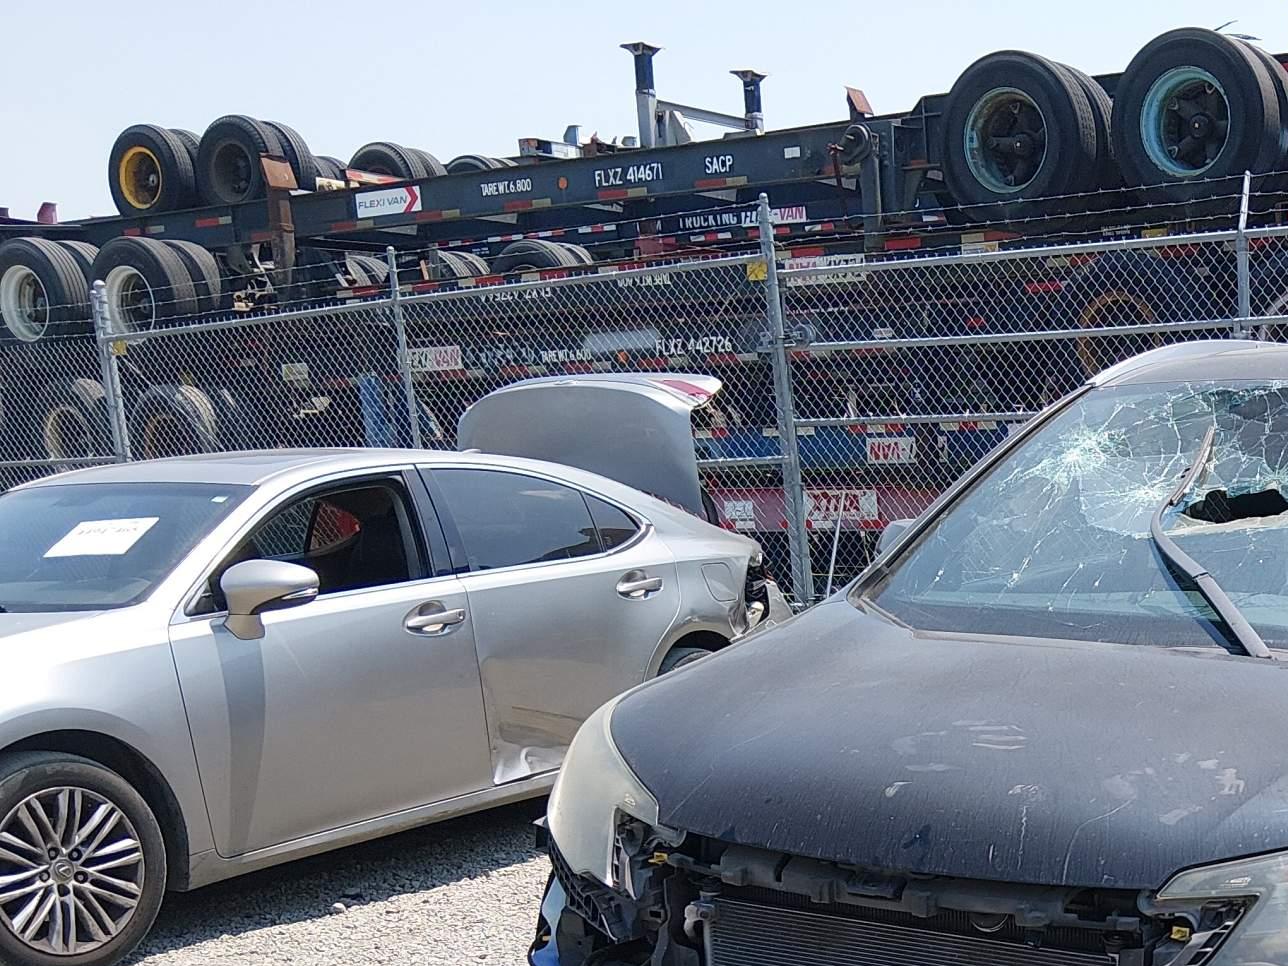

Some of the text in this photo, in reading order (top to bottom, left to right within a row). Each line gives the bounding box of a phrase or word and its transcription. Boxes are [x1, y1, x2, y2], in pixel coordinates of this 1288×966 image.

[704, 155, 733, 174] SACP
[594, 162, 663, 187] FLXZ 414671
[358, 195, 408, 209] FLEXI VAN
[655, 336, 733, 356] FLXZ 442726
